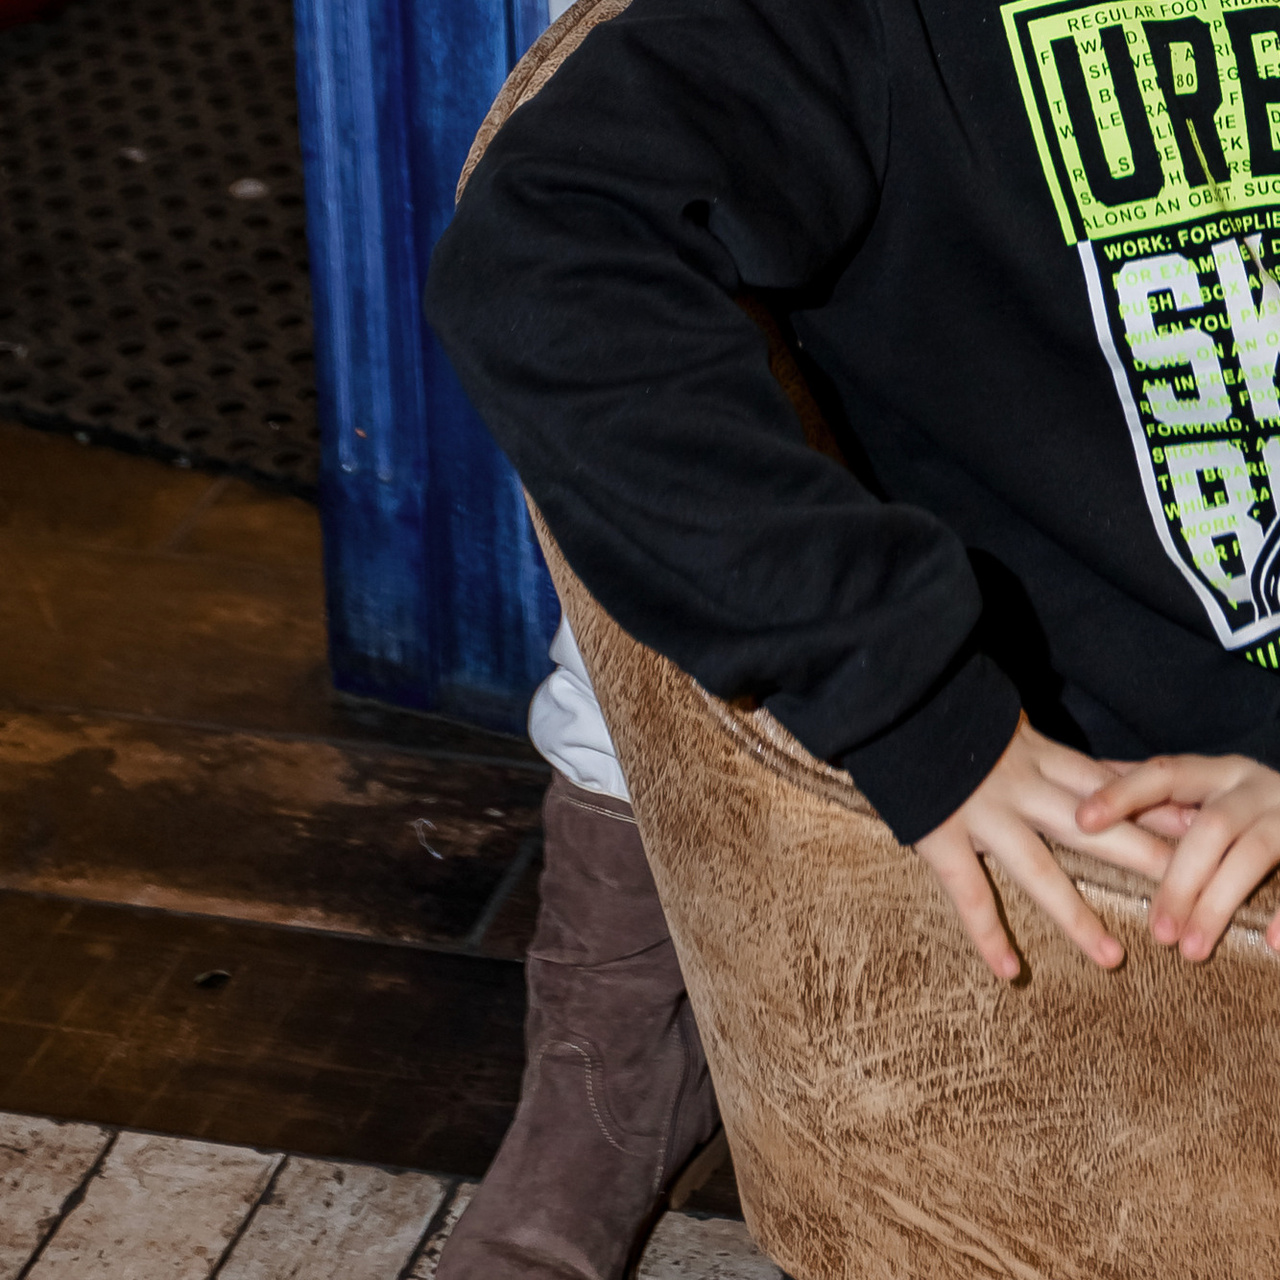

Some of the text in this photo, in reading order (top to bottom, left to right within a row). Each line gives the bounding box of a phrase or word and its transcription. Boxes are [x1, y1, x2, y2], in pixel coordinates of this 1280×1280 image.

[1067, 5, 1156, 33] REGULAR
[1083, 205, 1147, 230] ALONG
[1154, 198, 1181, 217] AN
[1103, 234, 1172, 261] WORK:
[1112, 266, 1153, 291] FOR
[1118, 292, 1174, 321] PUSH
[1199, 281, 1241, 304] BOX
[1124, 320, 1185, 349] WHEN
[1189, 312, 1232, 333] YOU
[1132, 350, 1190, 372] DONE
[1195, 342, 1225, 362] ON
[1231, 337, 1258, 359] AN
[1141, 377, 1168, 395] AN
[1145, 417, 1250, 439] FORWARD,
[1157, 471, 1197, 492] THE
[1164, 490, 1227, 522] WHILE
